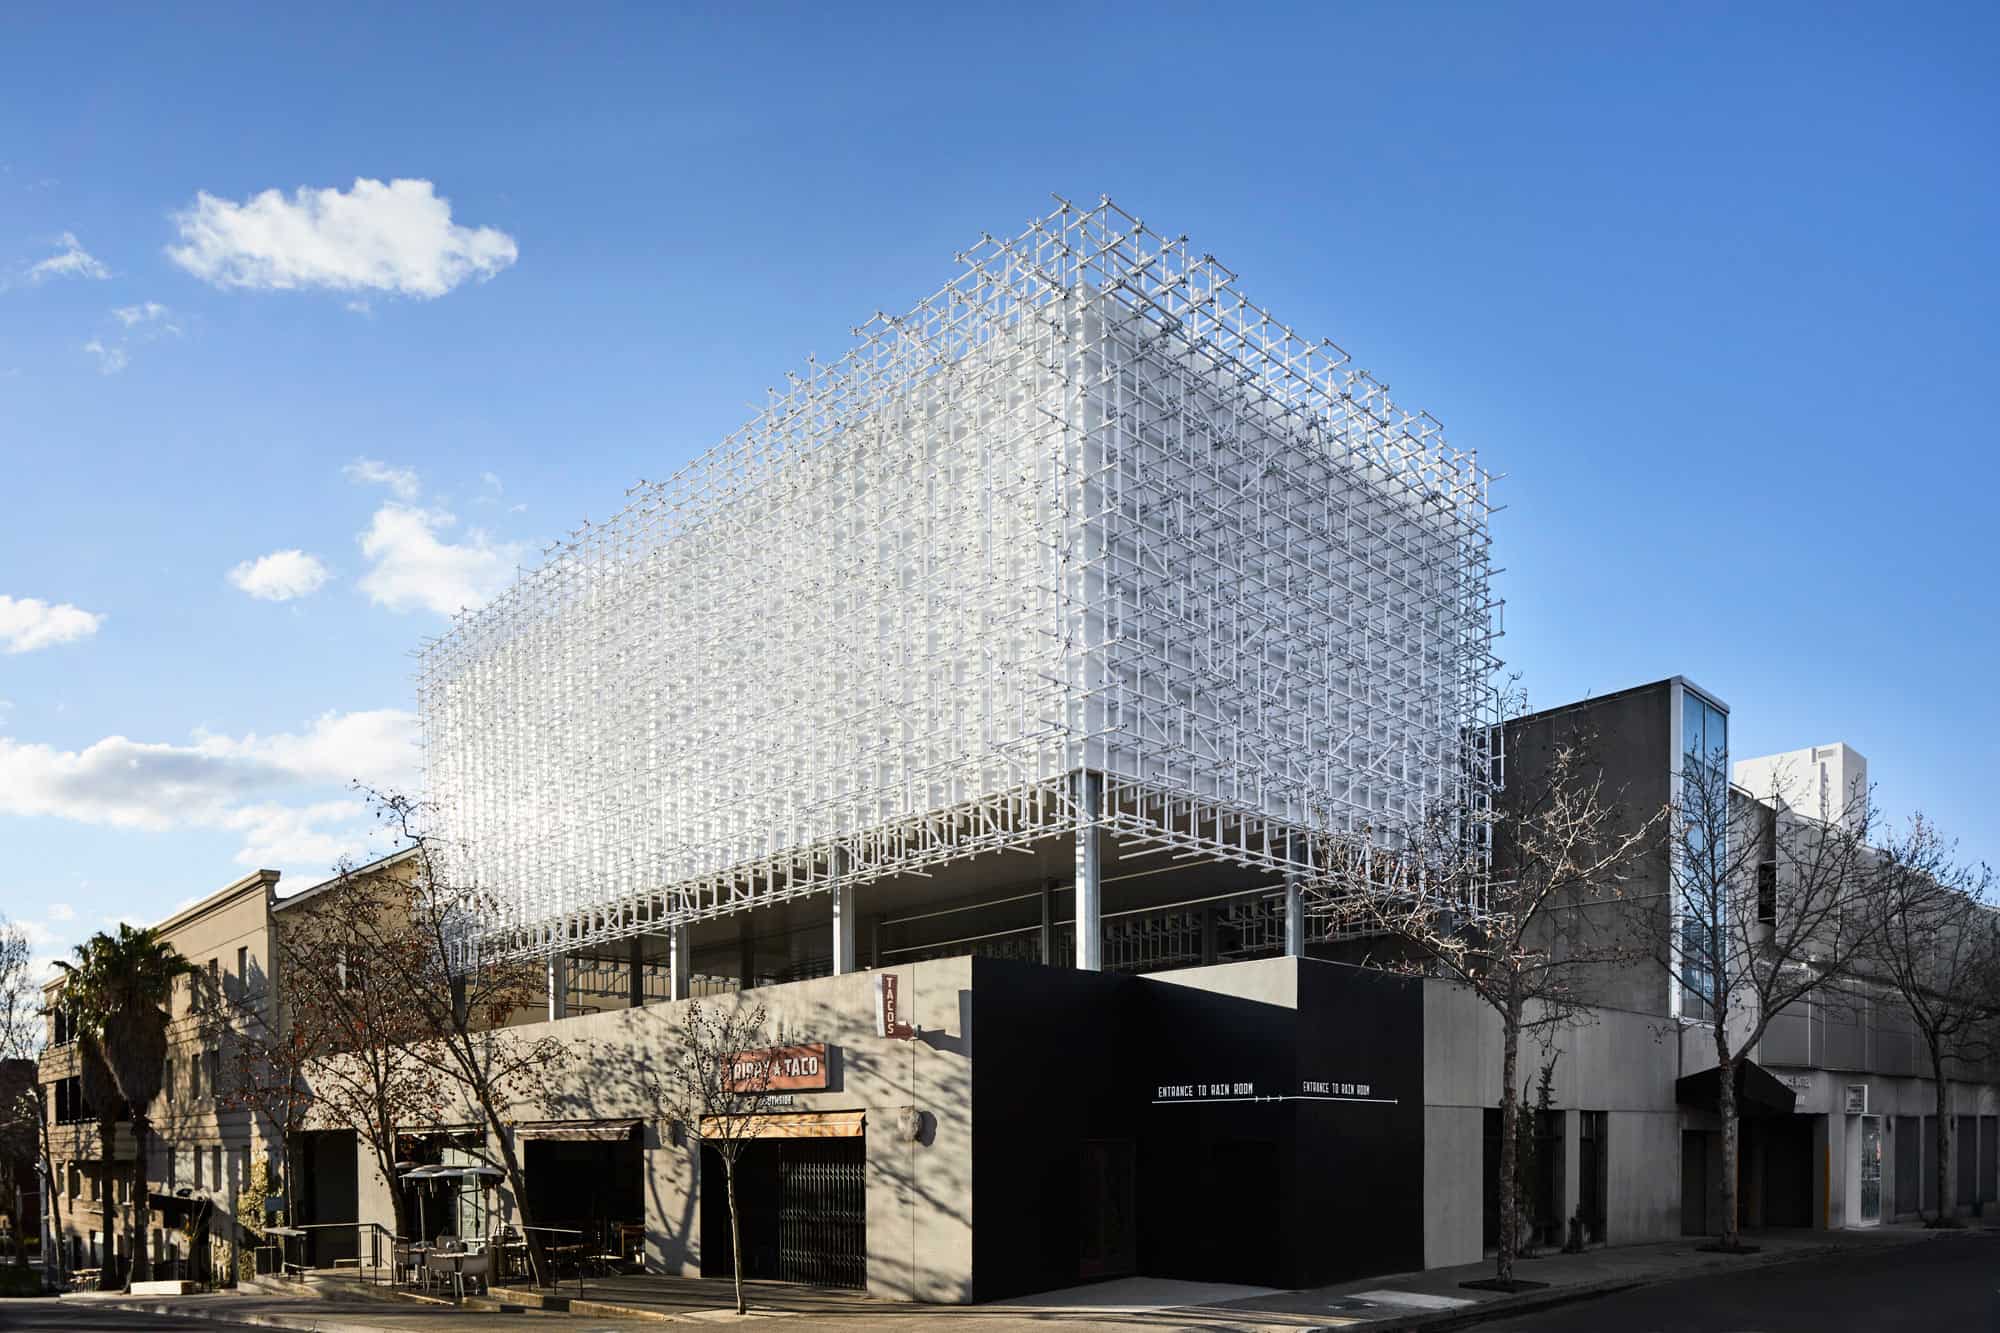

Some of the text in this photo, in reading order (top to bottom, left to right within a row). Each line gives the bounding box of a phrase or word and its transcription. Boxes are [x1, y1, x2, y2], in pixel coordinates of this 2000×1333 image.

[886, 977, 895, 1034] TACOS
[727, 1056, 818, 1081] TRIPPY TACO
[1158, 1082, 1254, 1097] ENTRANCE TO RAIN ROOM
[1303, 1081, 1370, 1097] ENTRANCE TO RAIN ROOM
